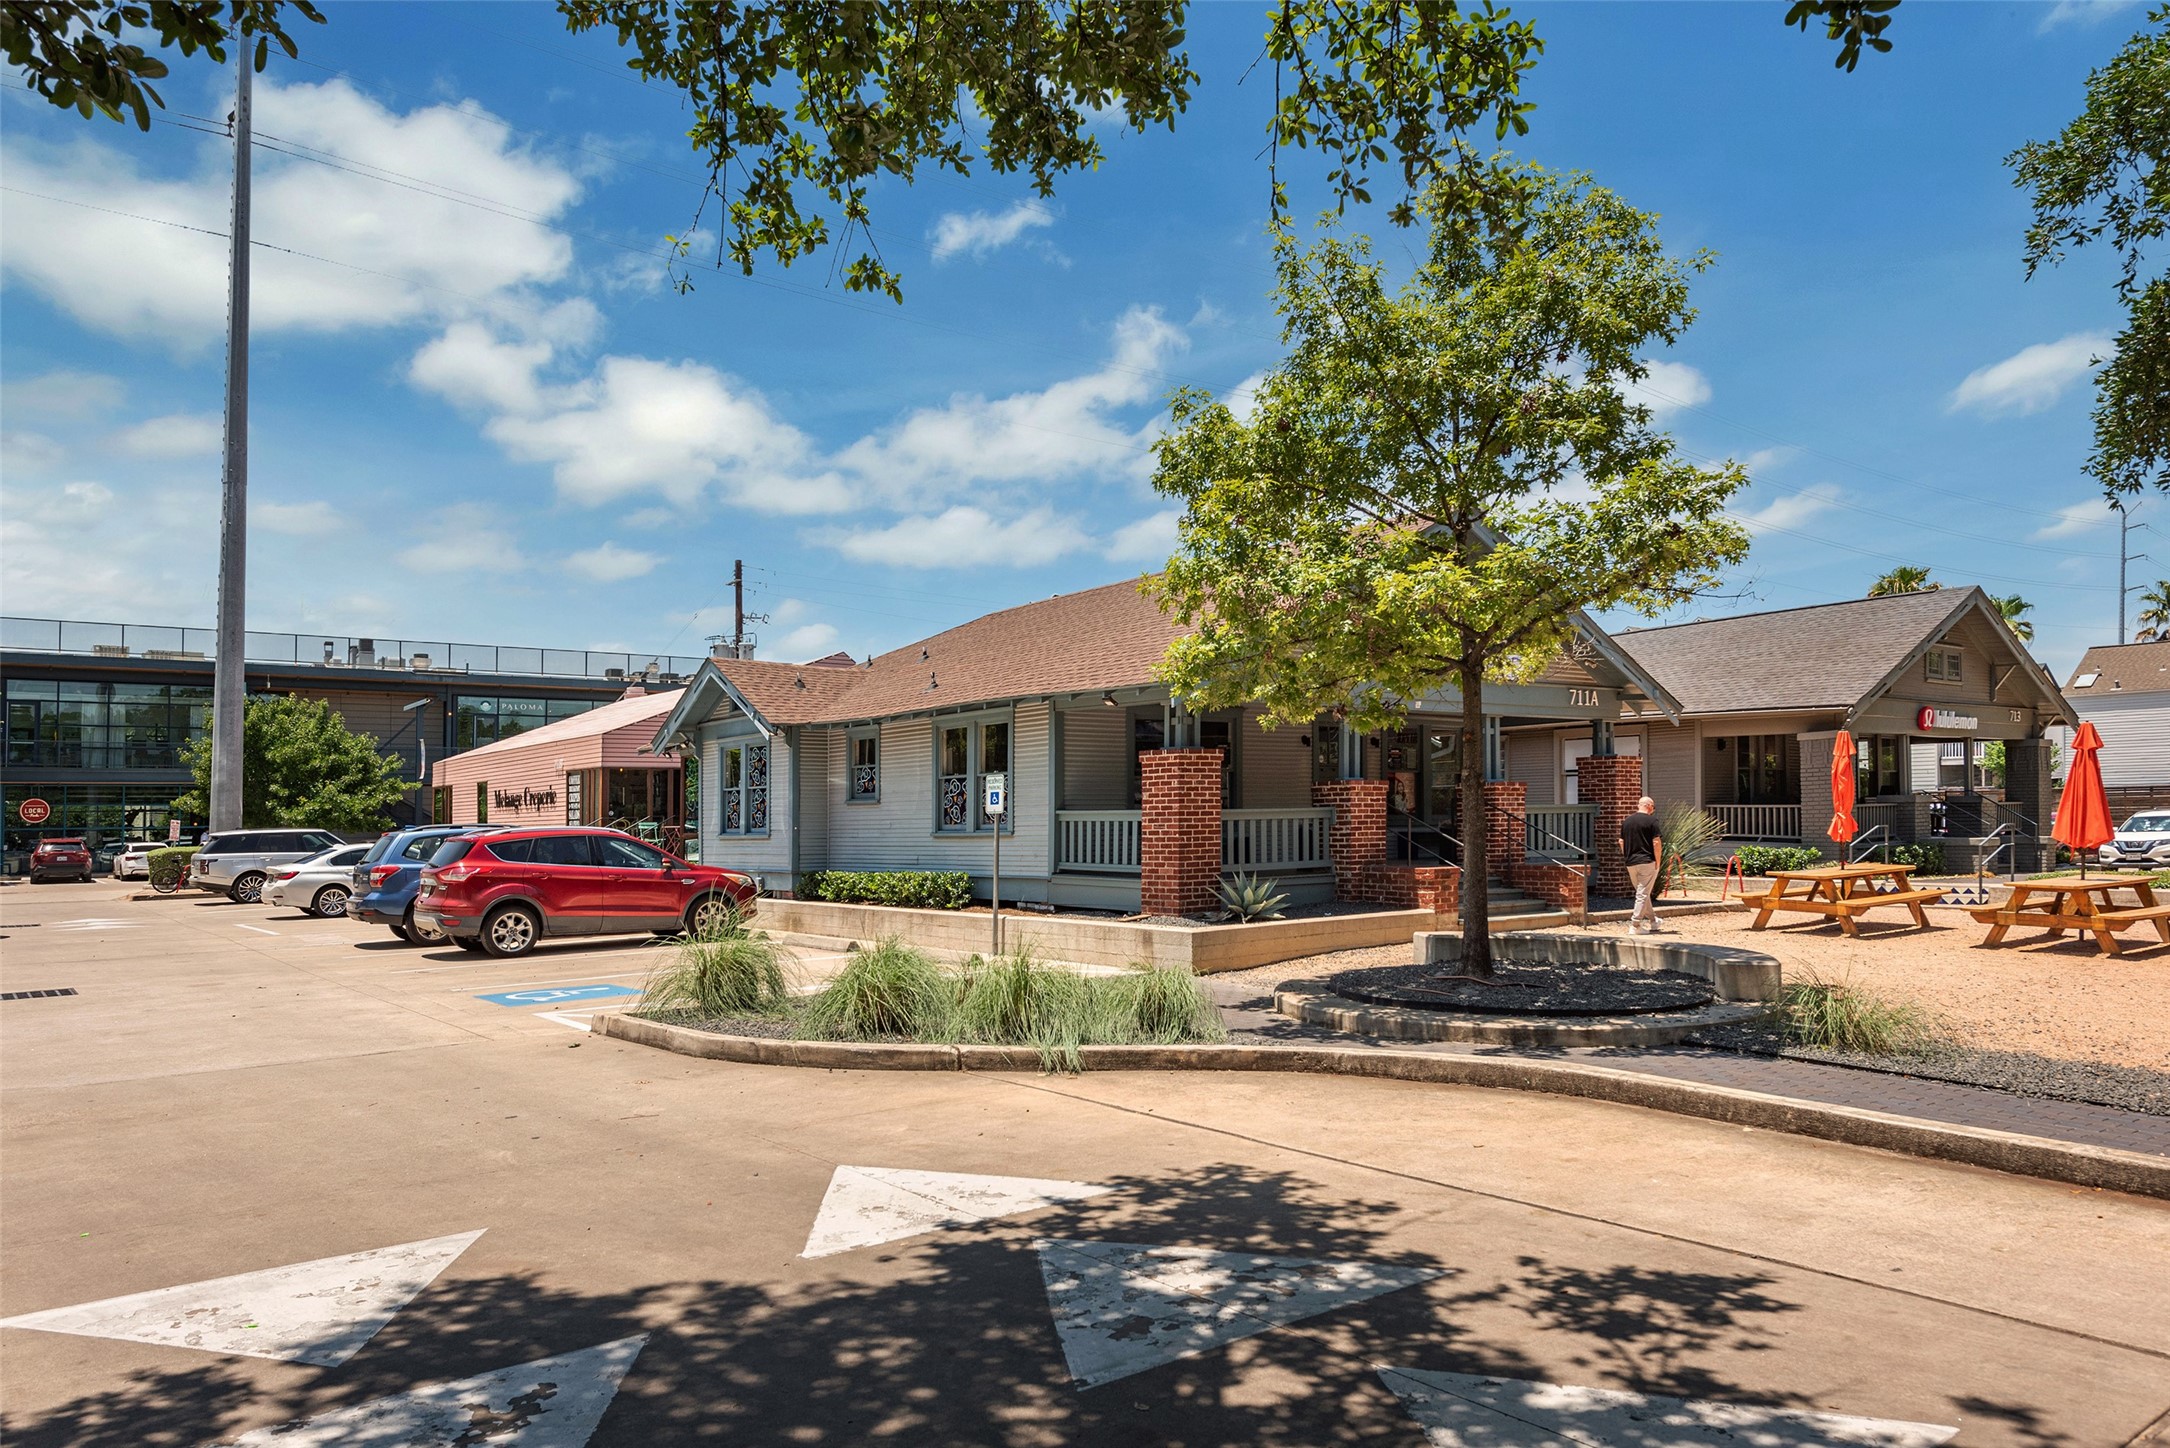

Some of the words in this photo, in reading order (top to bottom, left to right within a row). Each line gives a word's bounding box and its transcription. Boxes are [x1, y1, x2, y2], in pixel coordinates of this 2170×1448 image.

[1569, 689, 1599, 706] 711A
[501, 703, 544, 711] PALOMA
[1933, 709, 1978, 729] lululemon
[2009, 710, 2022, 722] 713
[524, 785, 557, 811] Creperie
